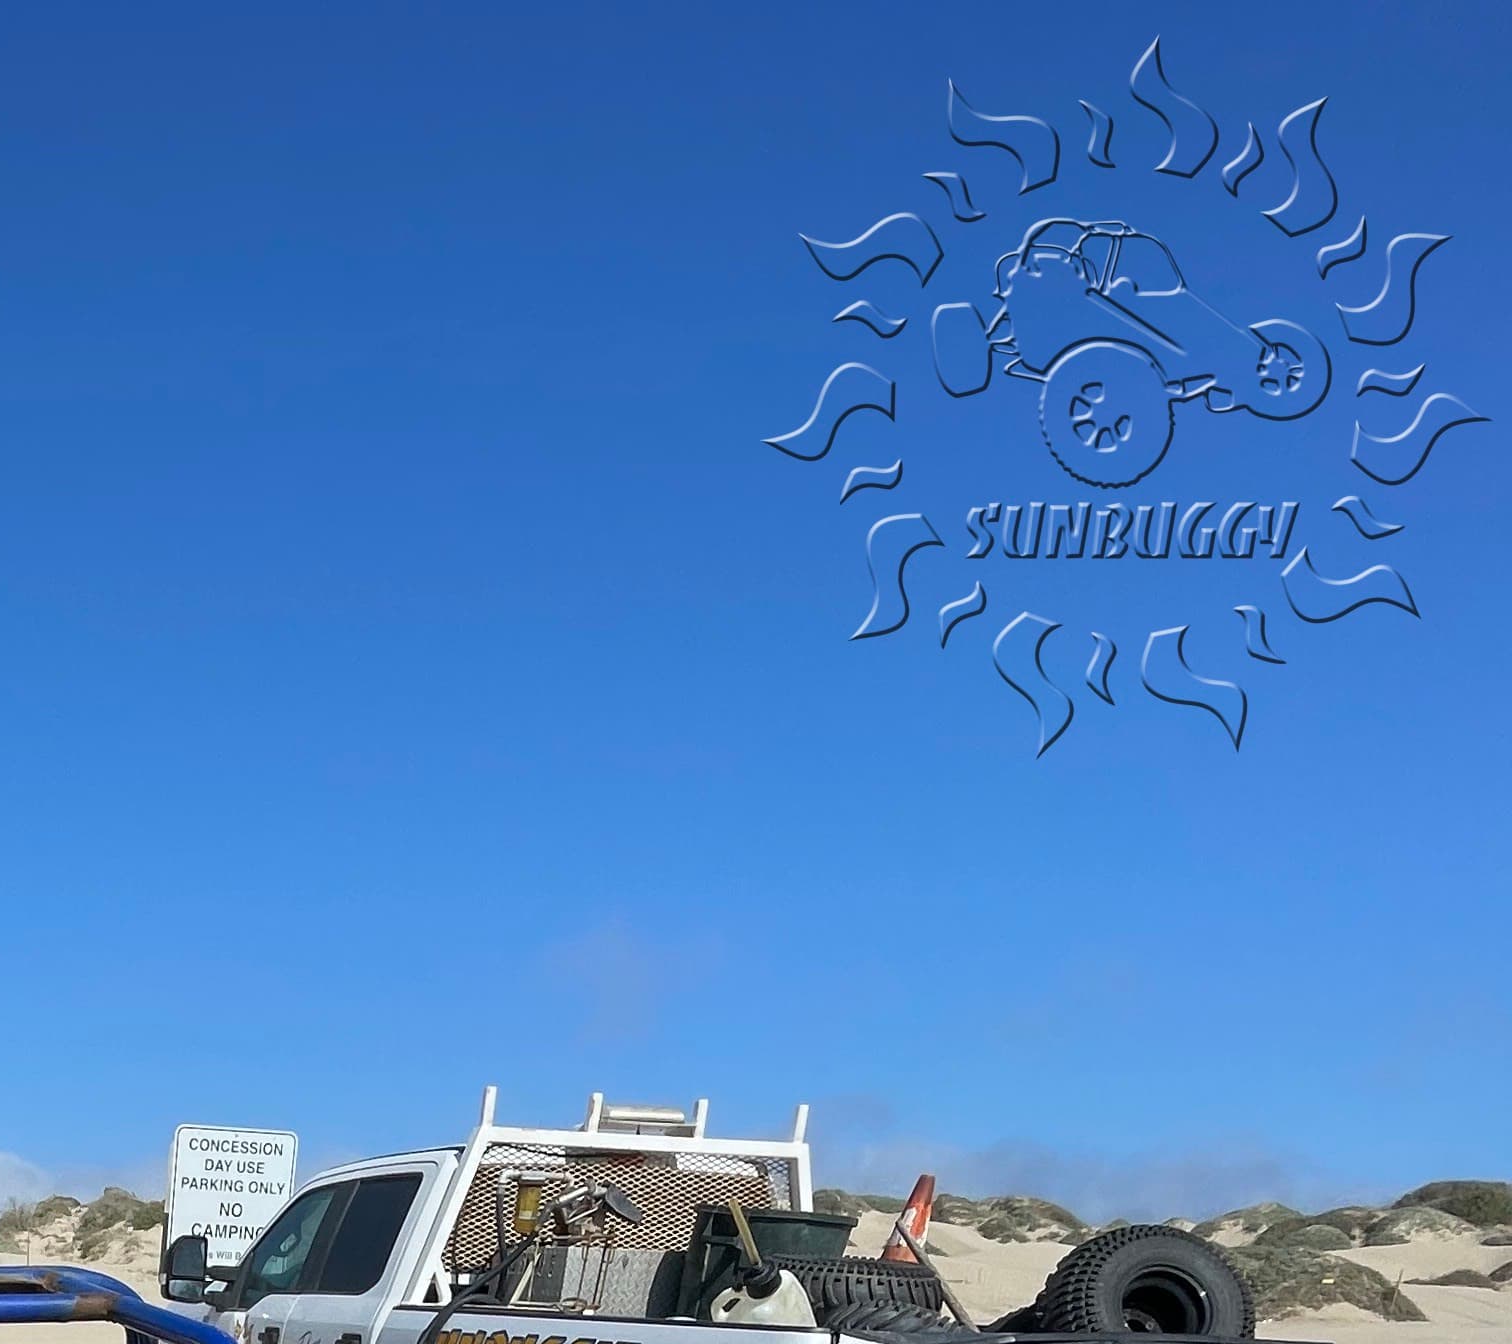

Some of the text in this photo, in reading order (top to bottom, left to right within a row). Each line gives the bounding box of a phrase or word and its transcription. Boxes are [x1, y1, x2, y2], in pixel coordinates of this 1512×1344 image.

[188, 1137, 284, 1156] CONCESSION
[204, 1158, 265, 1174] DAY USE
[181, 1177, 285, 1195] PARKING ONLY
[219, 1202, 243, 1217] NO
